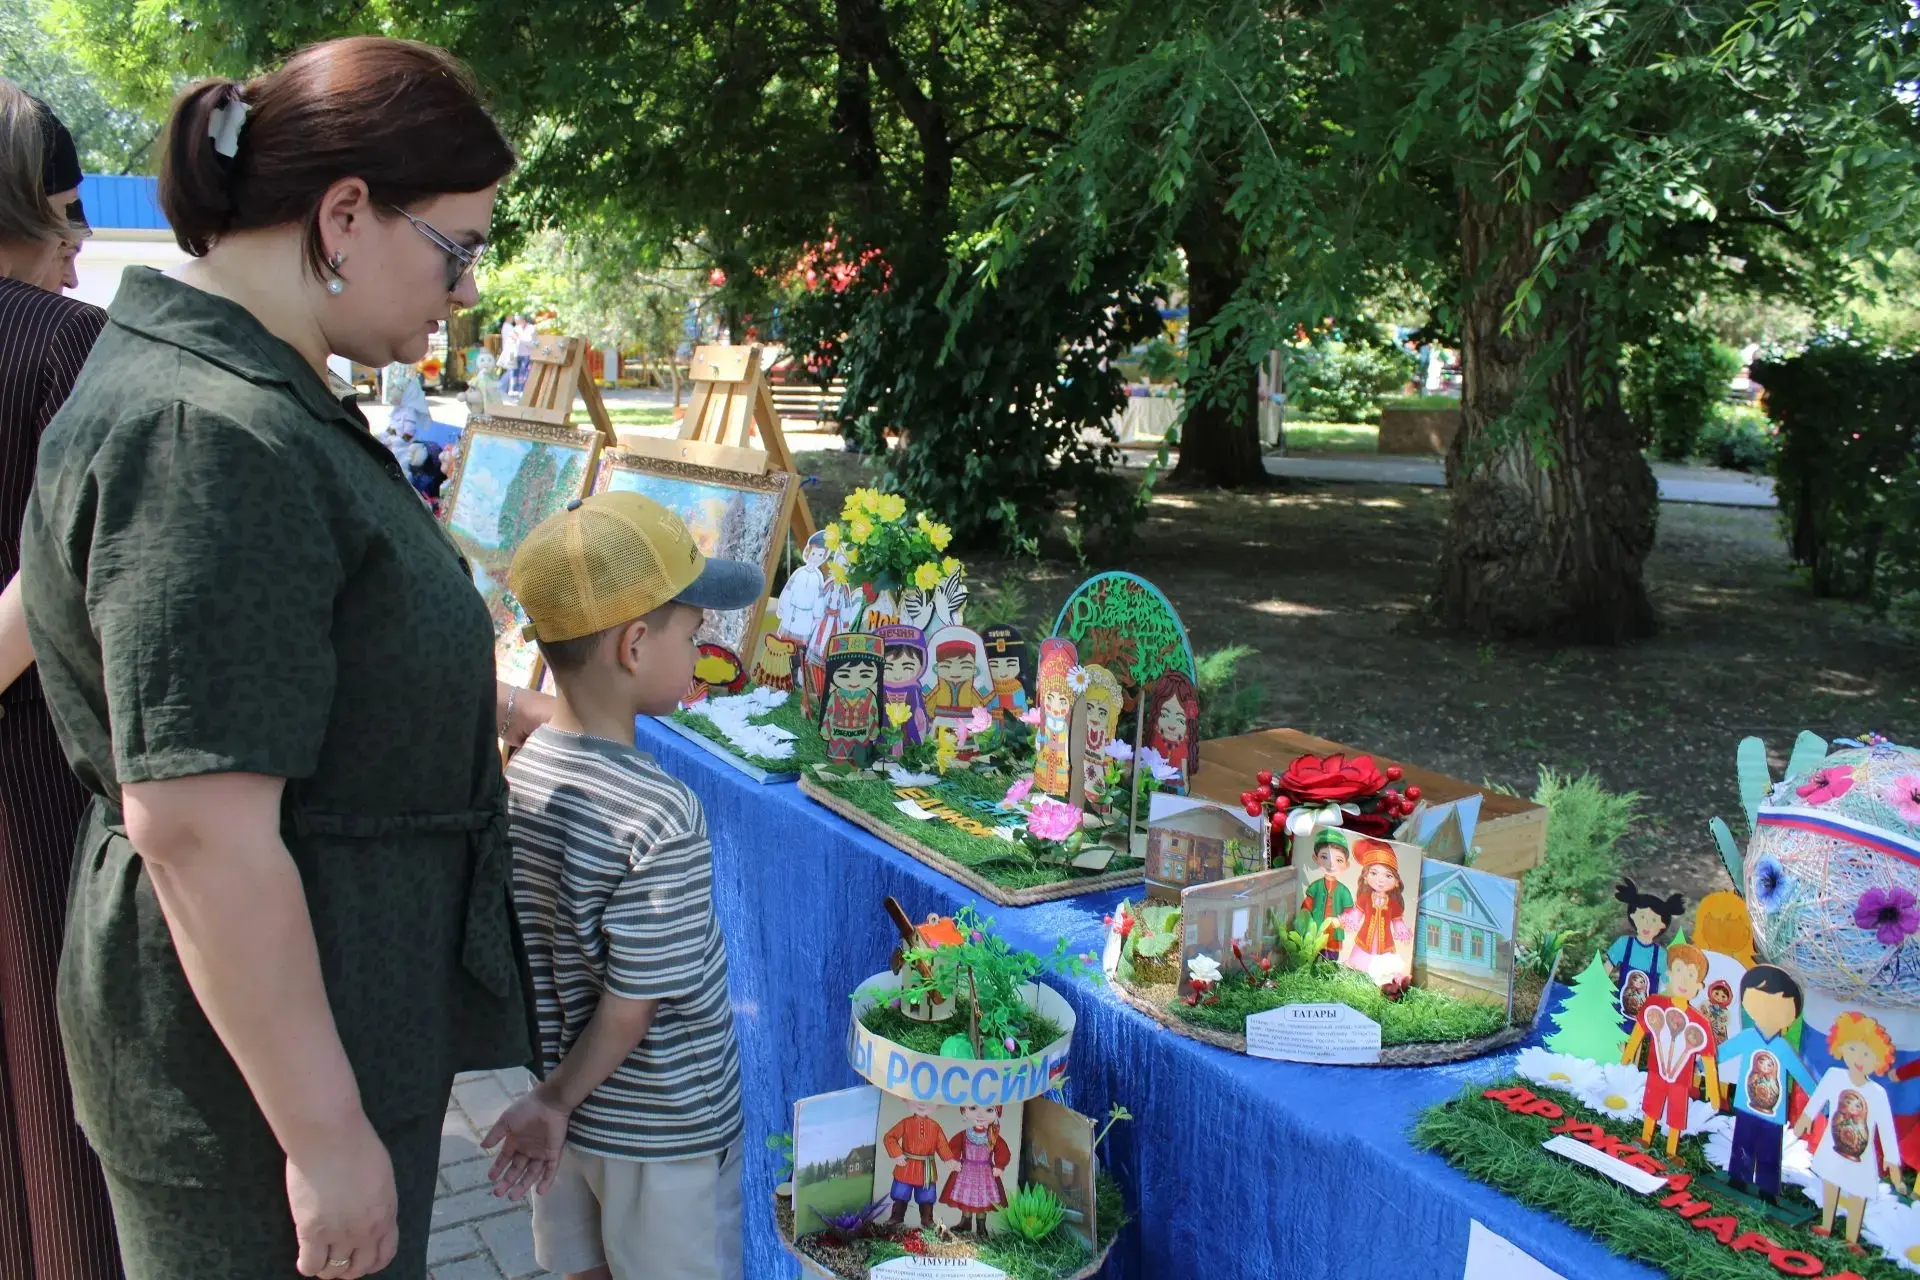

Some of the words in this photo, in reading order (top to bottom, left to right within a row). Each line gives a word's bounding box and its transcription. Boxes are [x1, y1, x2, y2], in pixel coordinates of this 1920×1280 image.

[1291, 1009, 1337, 1019] ТАТАРЫ
[887, 1051, 1049, 1105] РОССИИ
[911, 1256, 968, 1267] УДМУРТЫ
